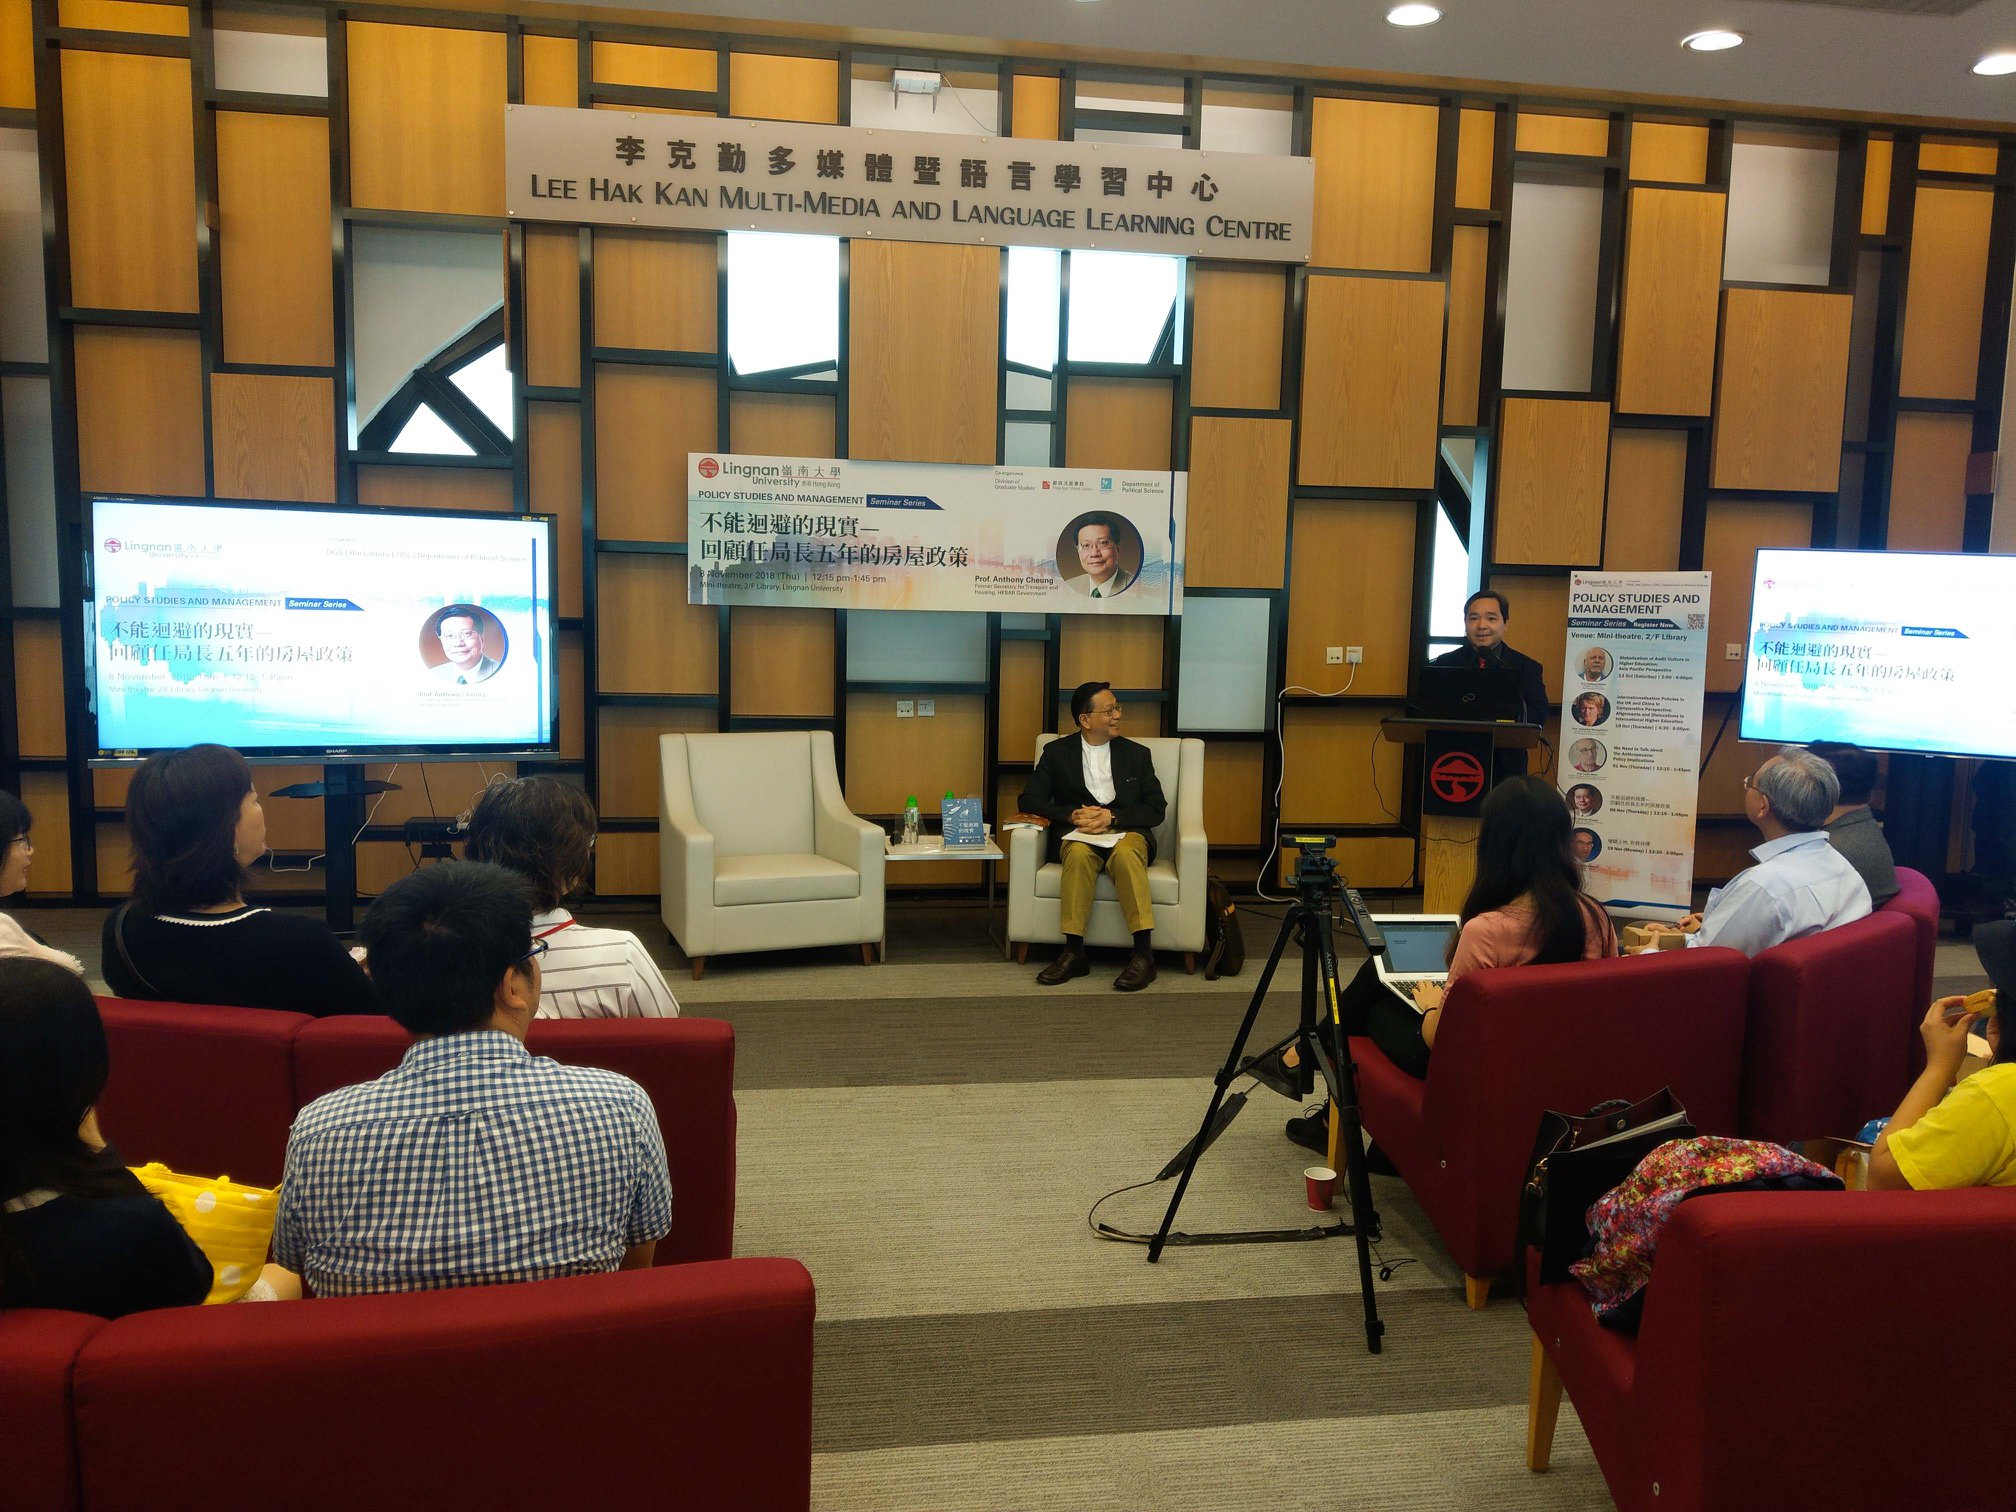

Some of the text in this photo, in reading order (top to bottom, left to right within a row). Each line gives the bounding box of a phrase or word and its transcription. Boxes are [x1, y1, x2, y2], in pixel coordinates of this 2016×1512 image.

[616, 136, 1219, 202] 李克勤多媒體暨語言學習中心
[531, 174, 1292, 241] LEE HAK KAN MULTI-MEDIA AND LANGUAGE LEARNING CENTRE
[722, 461, 779, 478] Lingnan
[752, 476, 800, 488] University
[1121, 481, 1153, 489] Department
[698, 490, 864, 505] POLICY STUDIES AND MANAGEMENT
[870, 497, 926, 508] Seminar Series
[124, 541, 172, 553] Lingnan
[700, 539, 968, 568] 回顧任局長五年的房屋政策
[699, 570, 705, 578] 8
[707, 570, 753, 580] November
[755, 571, 775, 580] 2018
[777, 571, 800, 582] (Thu)
[812, 573, 834, 582] 12:15
[872, 576, 886, 585] pm
[975, 575, 1054, 586] Prof. Anthony Cheung
[699, 581, 742, 590] Mini-theatre,
[744, 582, 755, 590] 2/F
[782, 583, 809, 593] Lingnan
[811, 584, 844, 593] University
[105, 595, 282, 607] POLICY STUDIES AND MANAGEMENT
[289, 599, 347, 609] Seminar Series
[1573, 593, 1700, 604] POLICY STUDIES AND
[1572, 604, 1662, 615] MANAGEMENT
[1571, 619, 1601, 627] Seminar
[1603, 619, 1627, 628] Series
[1759, 621, 1898, 634] POLICY STUDIES AND MANAGEMENT
[1571, 631, 1687, 643] Venue: Mini-theatre, 2/F Library
[1904, 628, 1956, 637] Seminar Series
[1326, 951, 1335, 978] SONY
